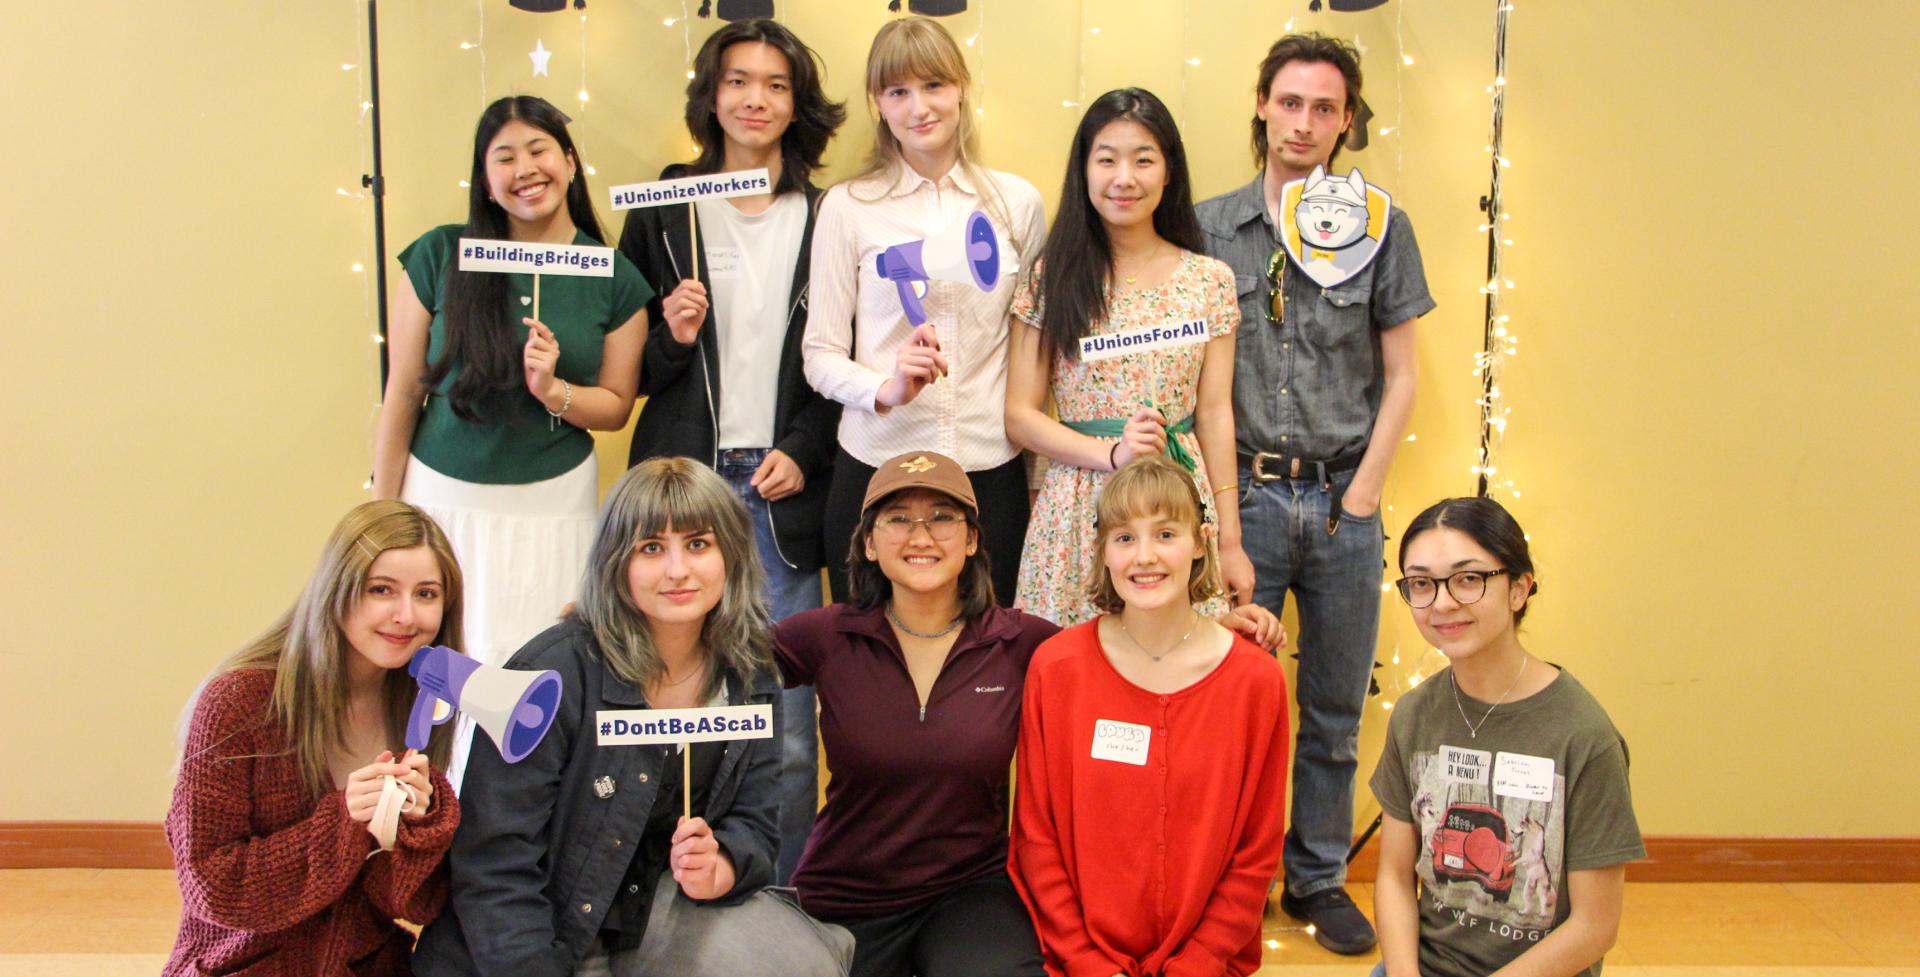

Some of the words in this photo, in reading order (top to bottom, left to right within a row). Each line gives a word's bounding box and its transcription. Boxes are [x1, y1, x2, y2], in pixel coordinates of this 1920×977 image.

[614, 177, 767, 206] #UnionizeWorkers
[464, 246, 609, 269] #BuildingBridges
[1083, 321, 1205, 353] #UnionsForAll
[600, 714, 767, 736] #DontBeAScab
[1447, 751, 1461, 763] HEY
[1447, 764, 1454, 776] A
